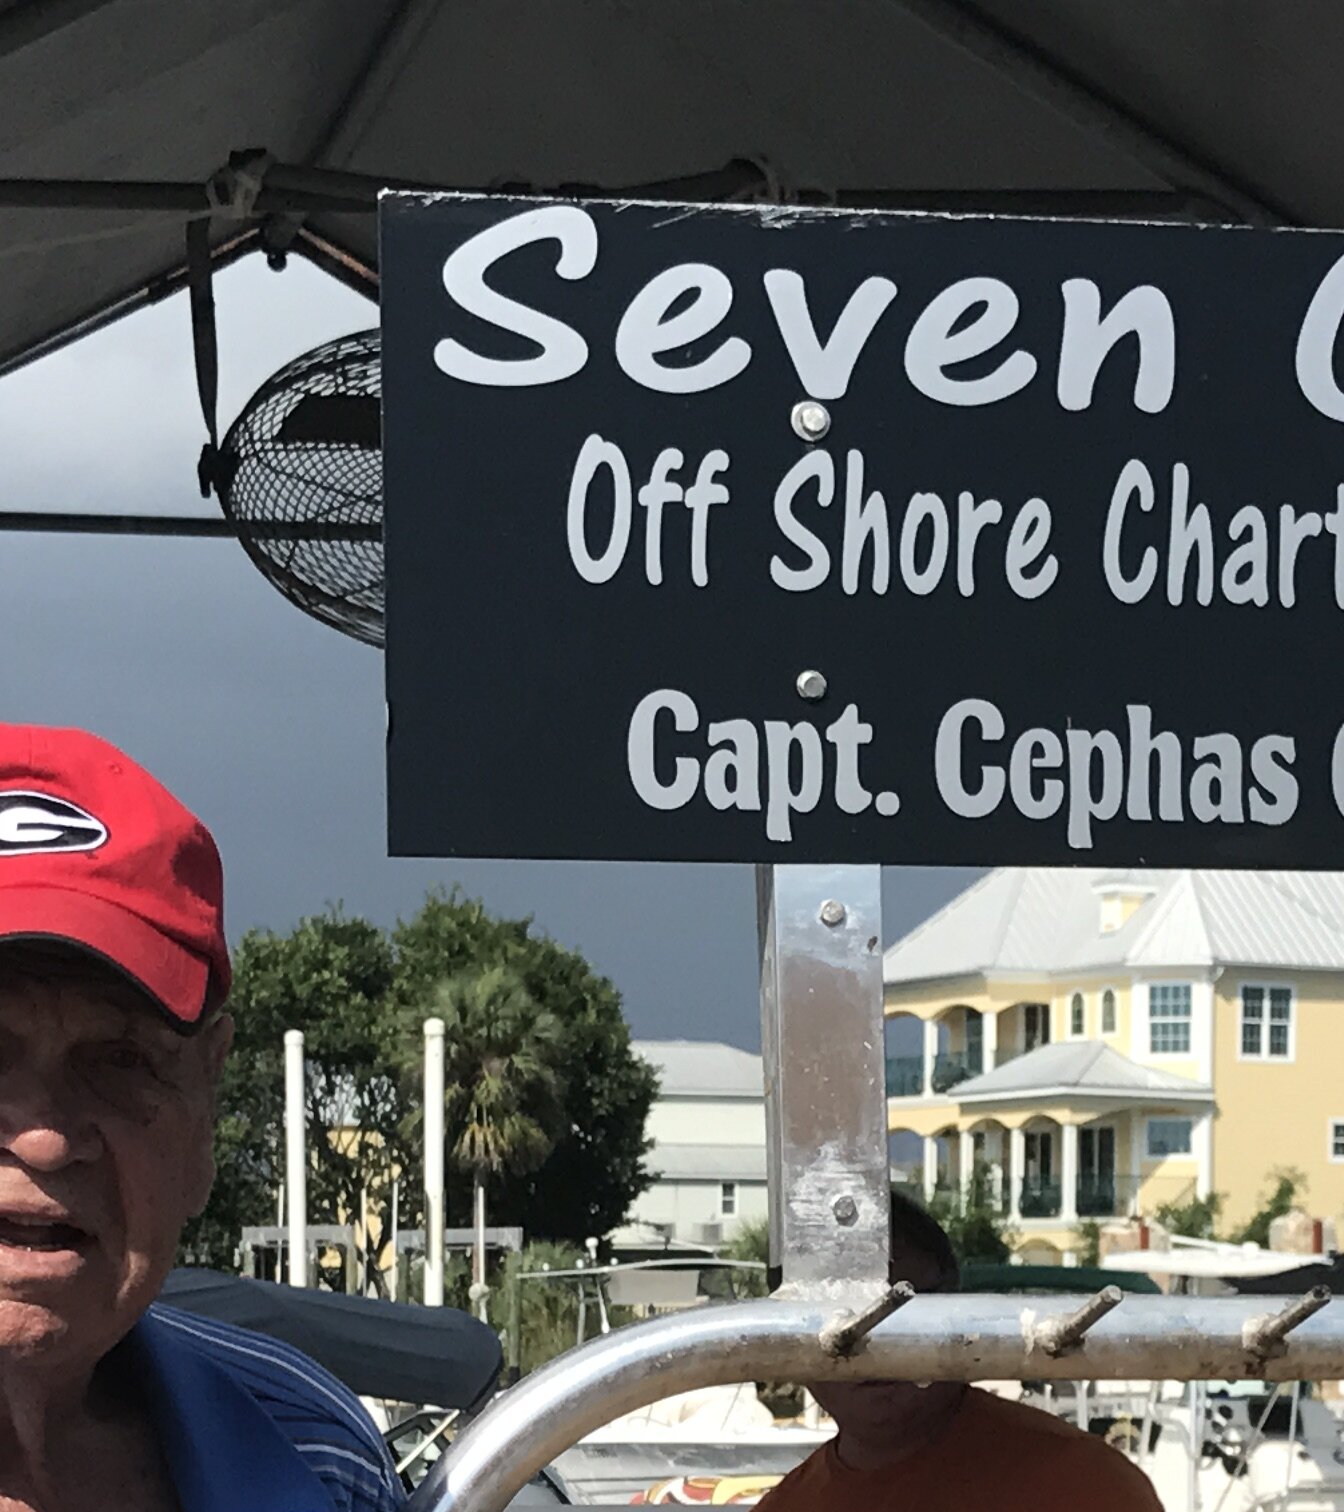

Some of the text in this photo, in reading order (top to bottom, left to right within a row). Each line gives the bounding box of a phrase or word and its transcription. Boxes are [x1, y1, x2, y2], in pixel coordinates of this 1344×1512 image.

[433, 206, 1176, 414] Seven
[567, 433, 730, 587] Off
[769, 448, 1059, 599] Shore
[627, 688, 900, 842] Capt.
[934, 698, 1299, 849] Cephas
